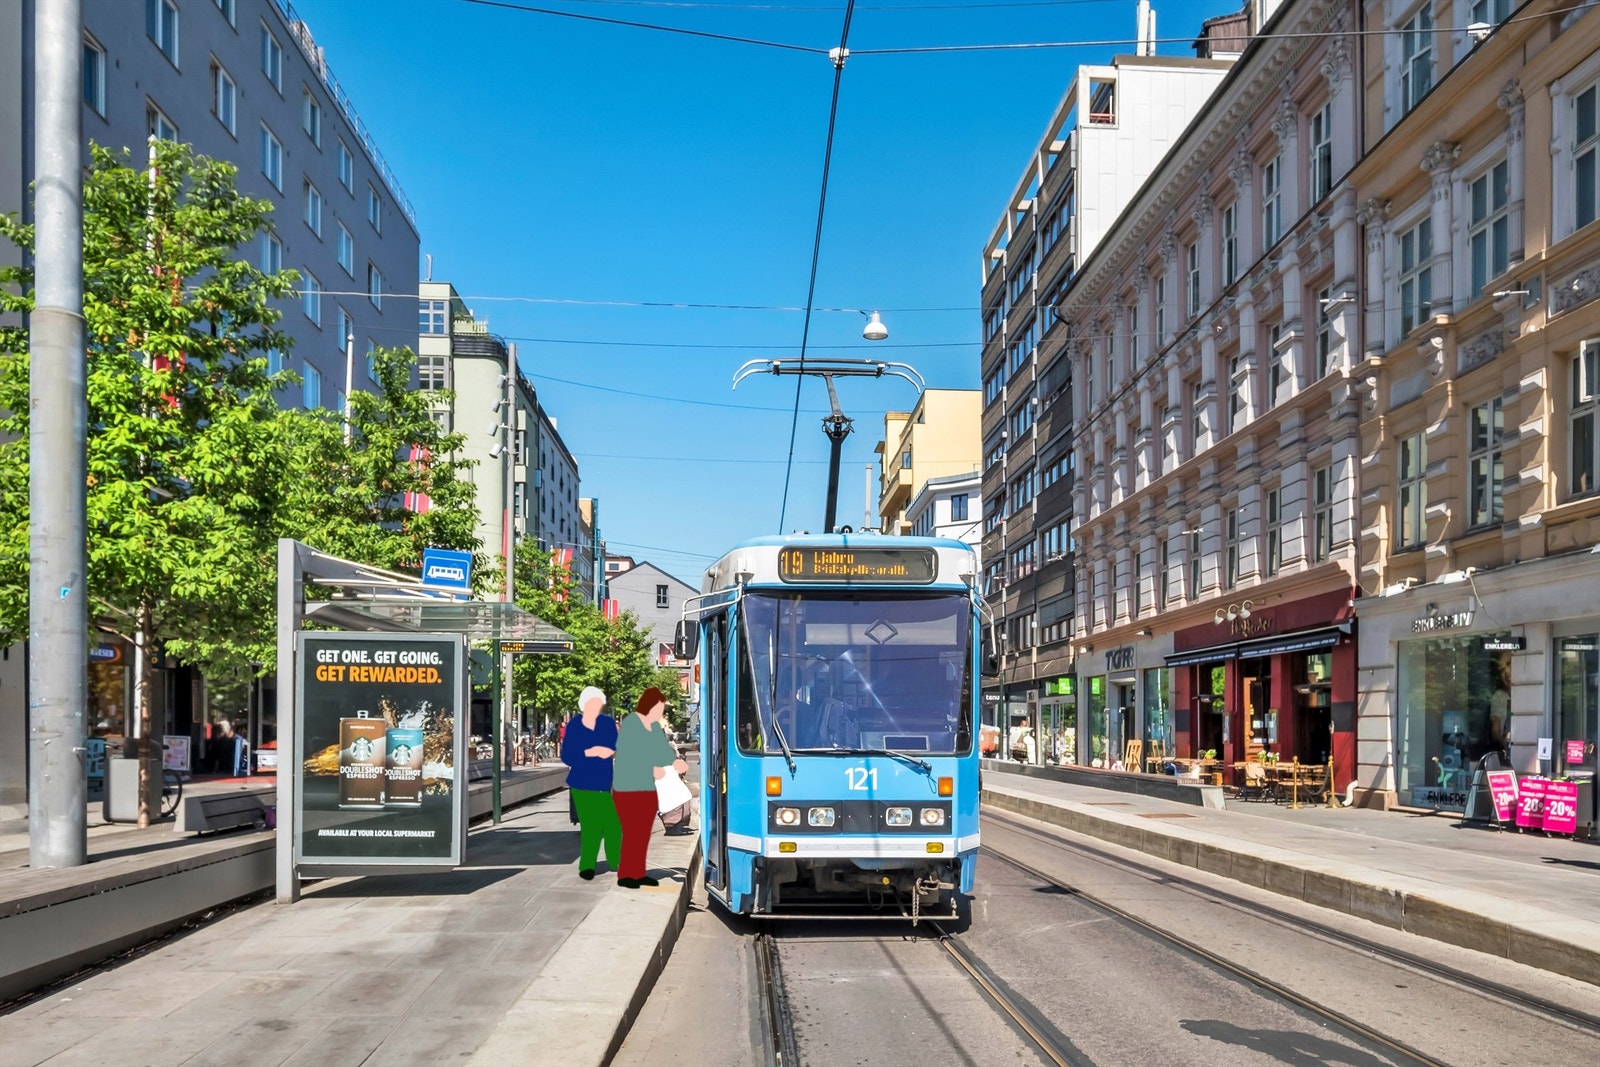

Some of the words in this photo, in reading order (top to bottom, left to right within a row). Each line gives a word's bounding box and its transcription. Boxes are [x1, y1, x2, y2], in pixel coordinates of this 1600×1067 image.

[780, 551, 803, 575] 19
[316, 649, 339, 663] GET
[341, 650, 371, 664] ONE.
[374, 651, 397, 664] GET
[399, 651, 443, 665] GOING.
[316, 665, 346, 682] GET
[349, 666, 442, 684] REWARDED.
[844, 767, 878, 791] 121
[1545, 801, 1575, 817] -20%
[318, 829, 349, 837] AVAILABLE
[350, 829, 357, 837] AT
[393, 830, 436, 838] SUPERMARKET
